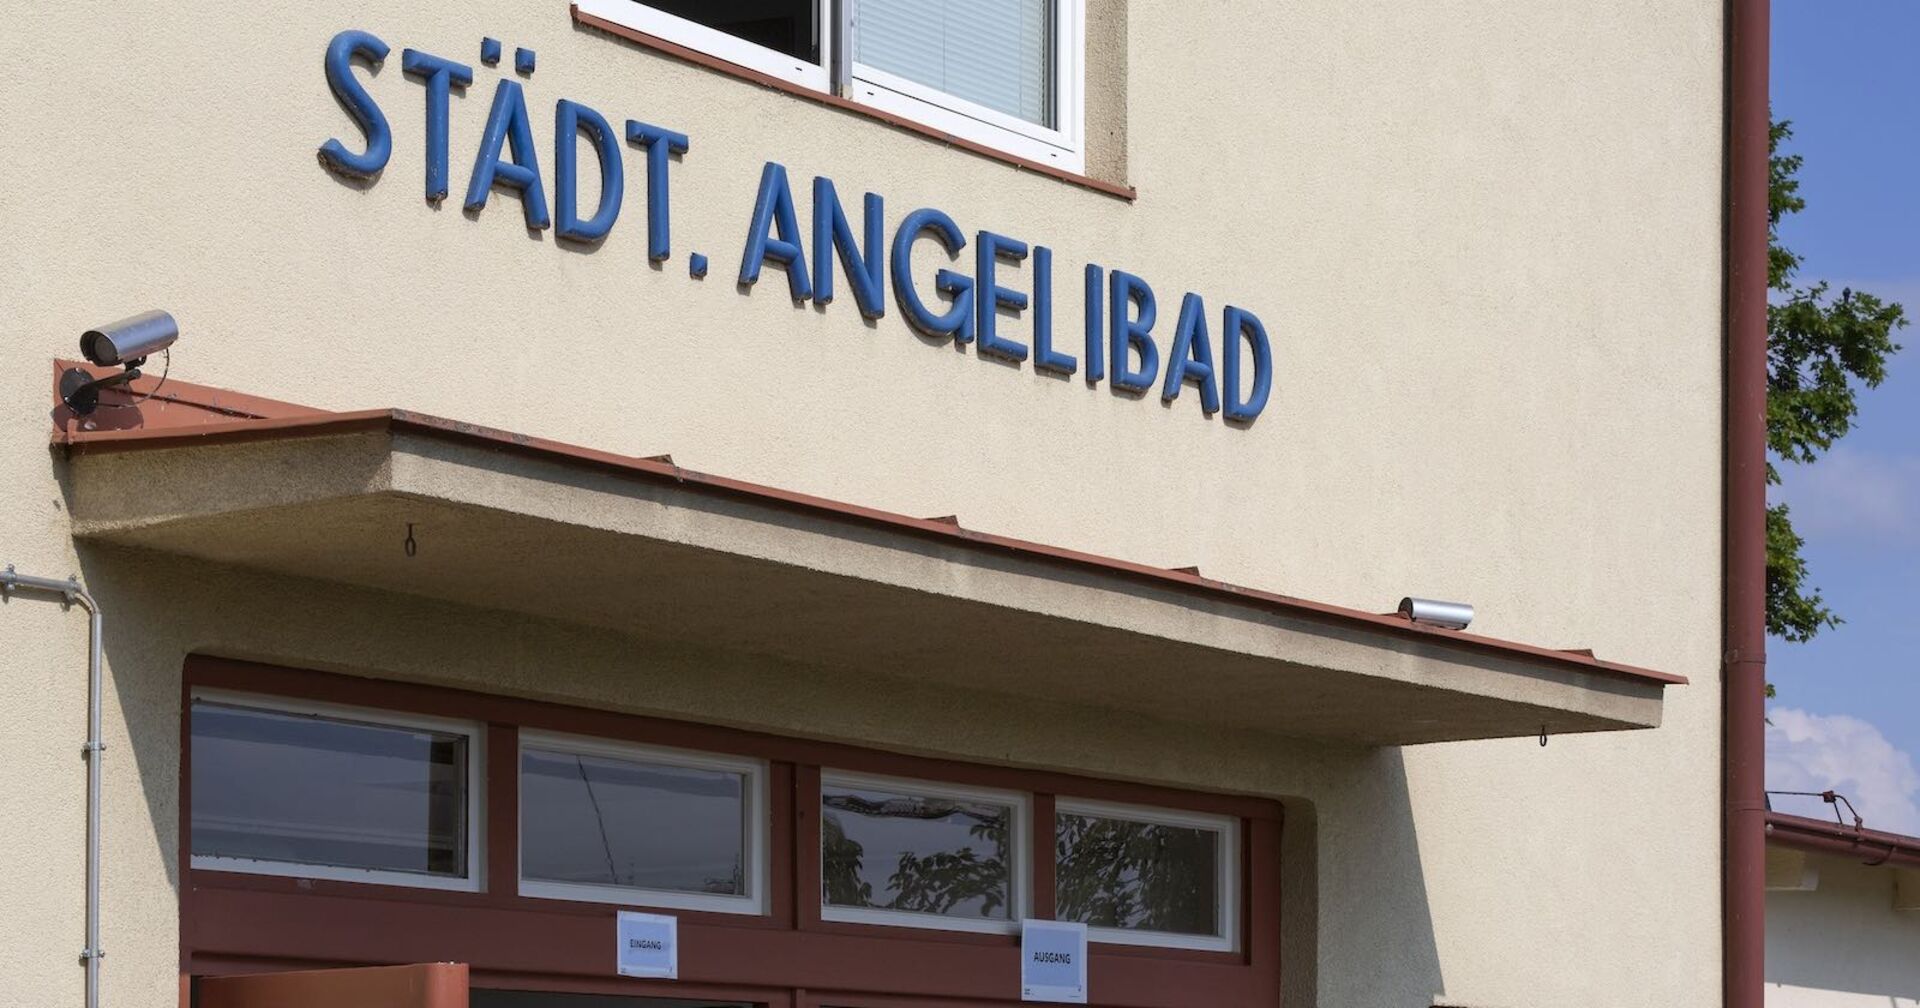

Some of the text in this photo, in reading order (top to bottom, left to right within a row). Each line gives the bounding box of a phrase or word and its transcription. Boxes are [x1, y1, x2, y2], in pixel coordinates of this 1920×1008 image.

[319, 29, 1274, 422] STÄDT. ANGELIBAD
[630, 938, 662, 950] EINGANG
[1033, 951, 1071, 965] AUSGANG
